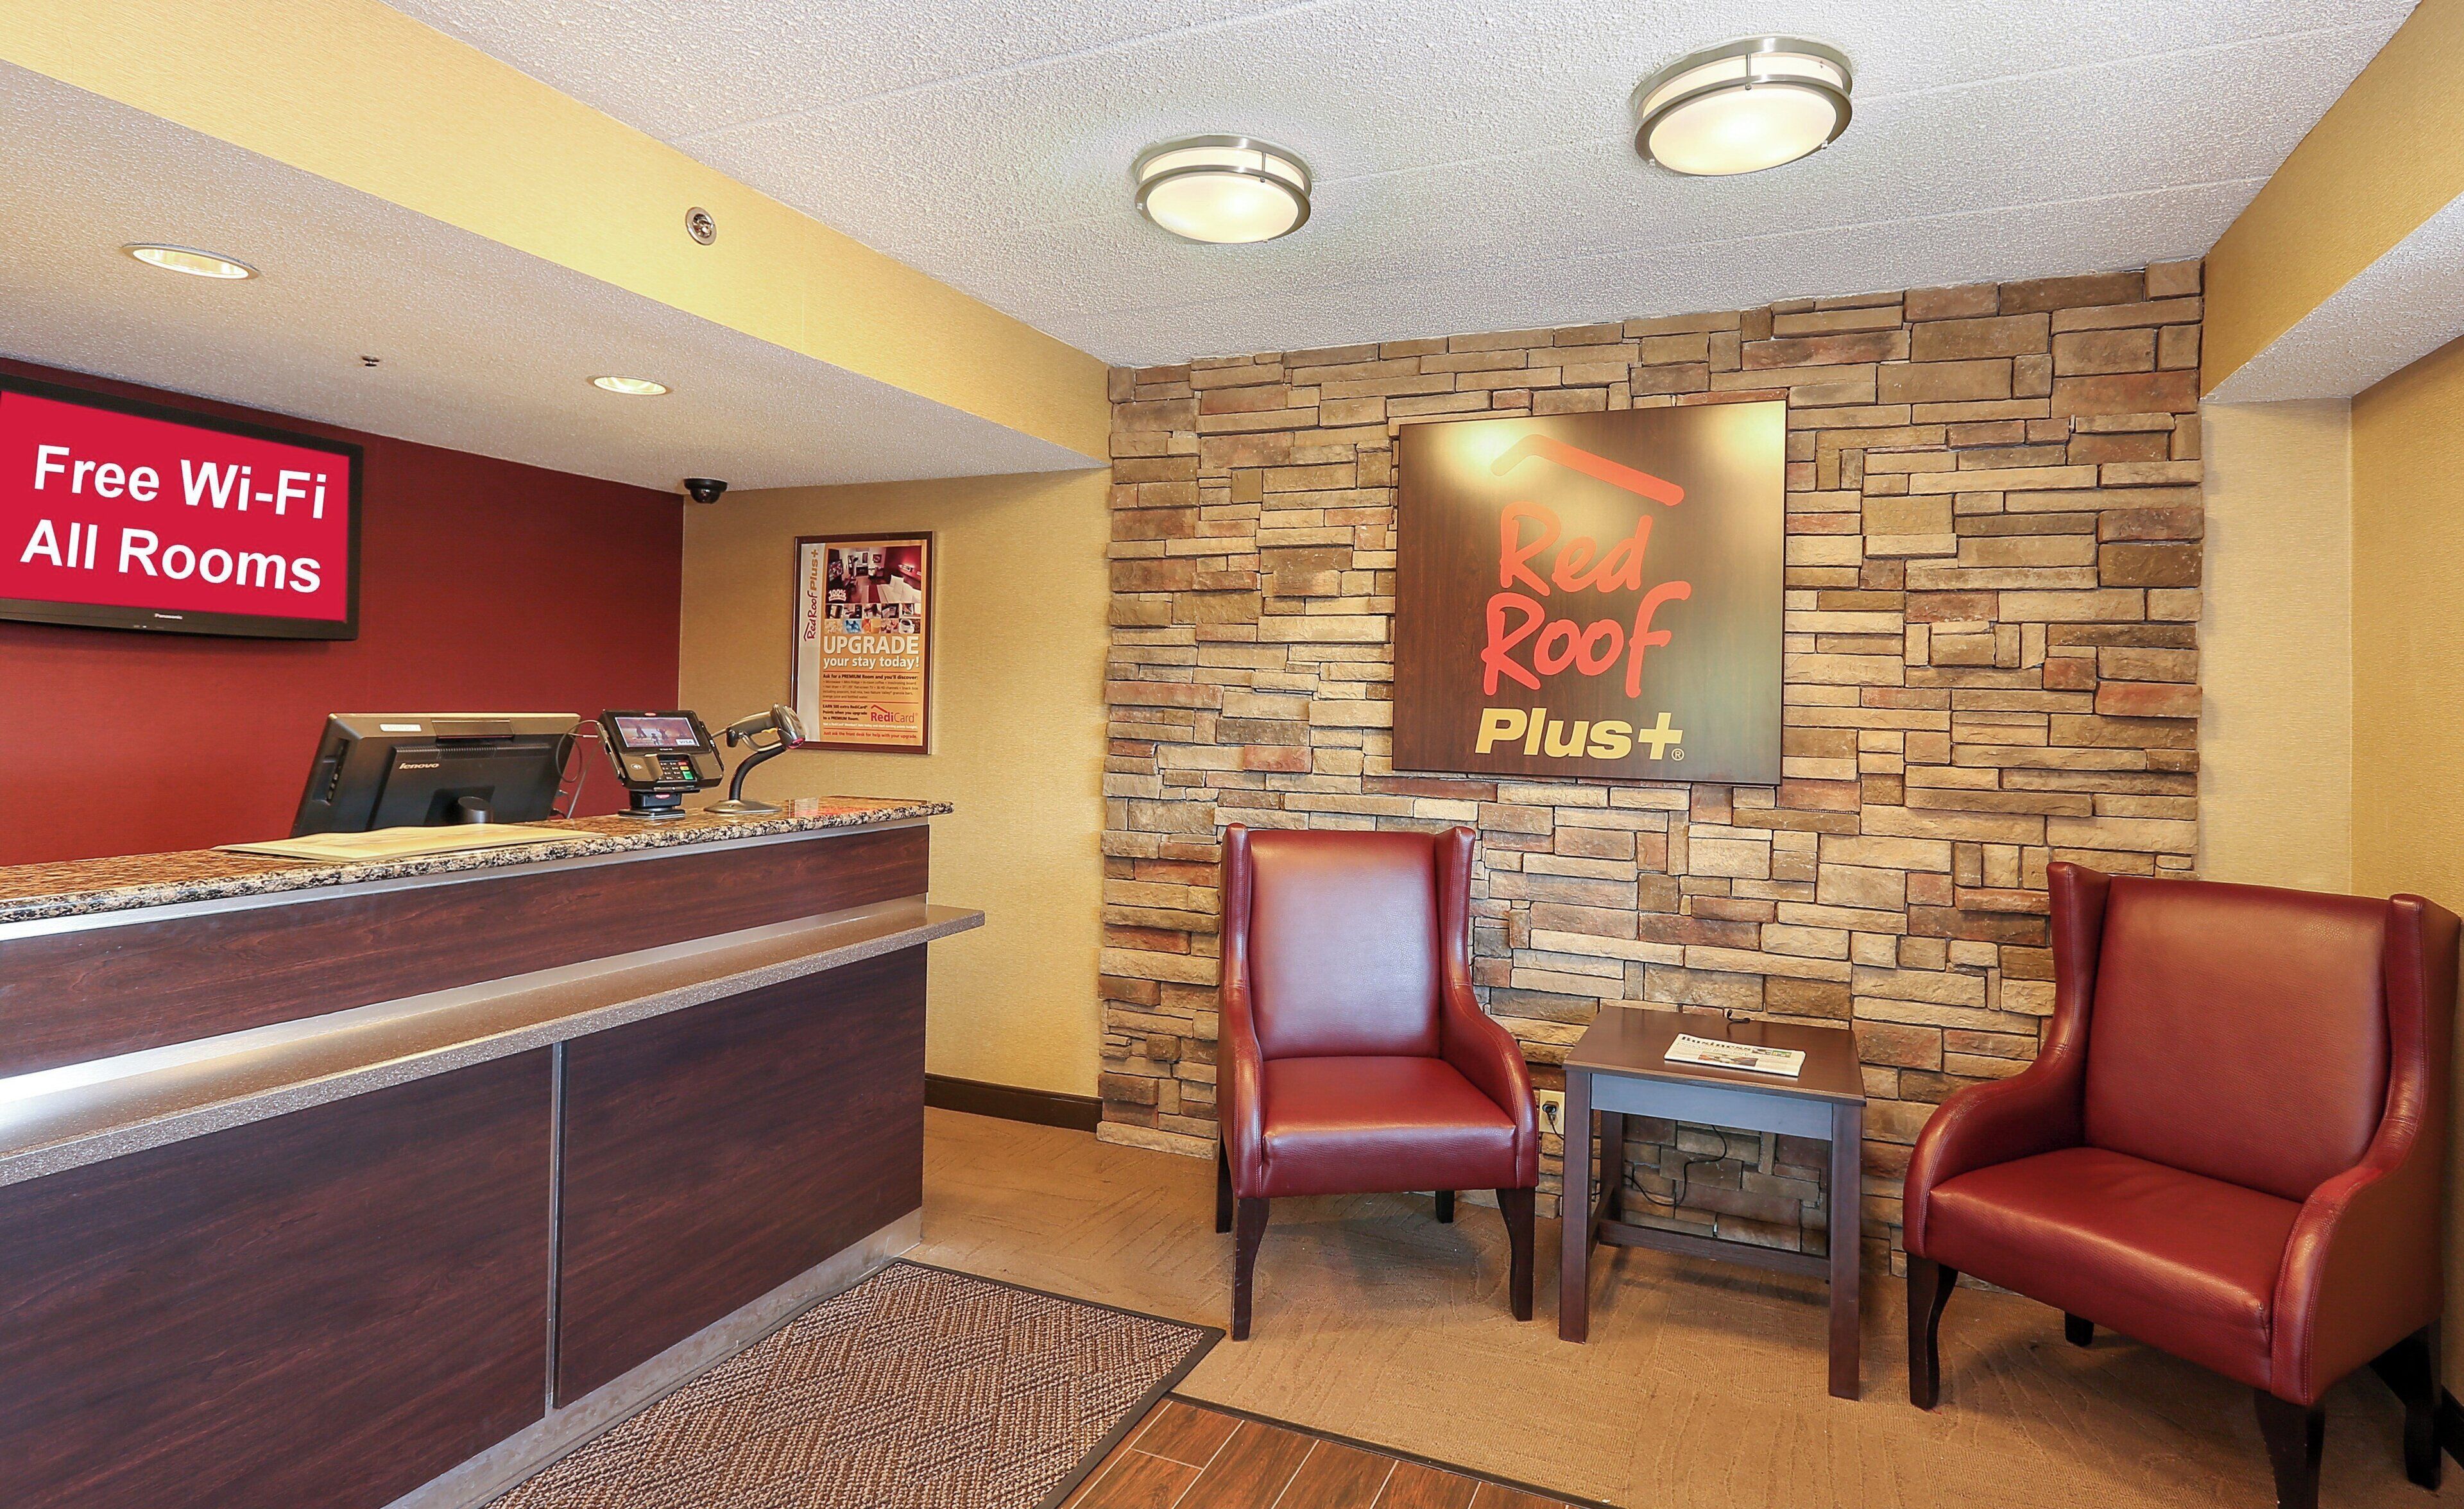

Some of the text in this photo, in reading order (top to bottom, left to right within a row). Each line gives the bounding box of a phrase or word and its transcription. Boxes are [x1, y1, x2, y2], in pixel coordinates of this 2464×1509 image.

[33, 444, 327, 520] Free Wi-Fi
[19, 518, 321, 593] All Rooms
[1499, 500, 1654, 597] Red
[828, 589, 846, 597] 100%
[823, 635, 920, 654] UPGRADE
[823, 655, 920, 670] your stay today!
[1480, 581, 1692, 699] Roof
